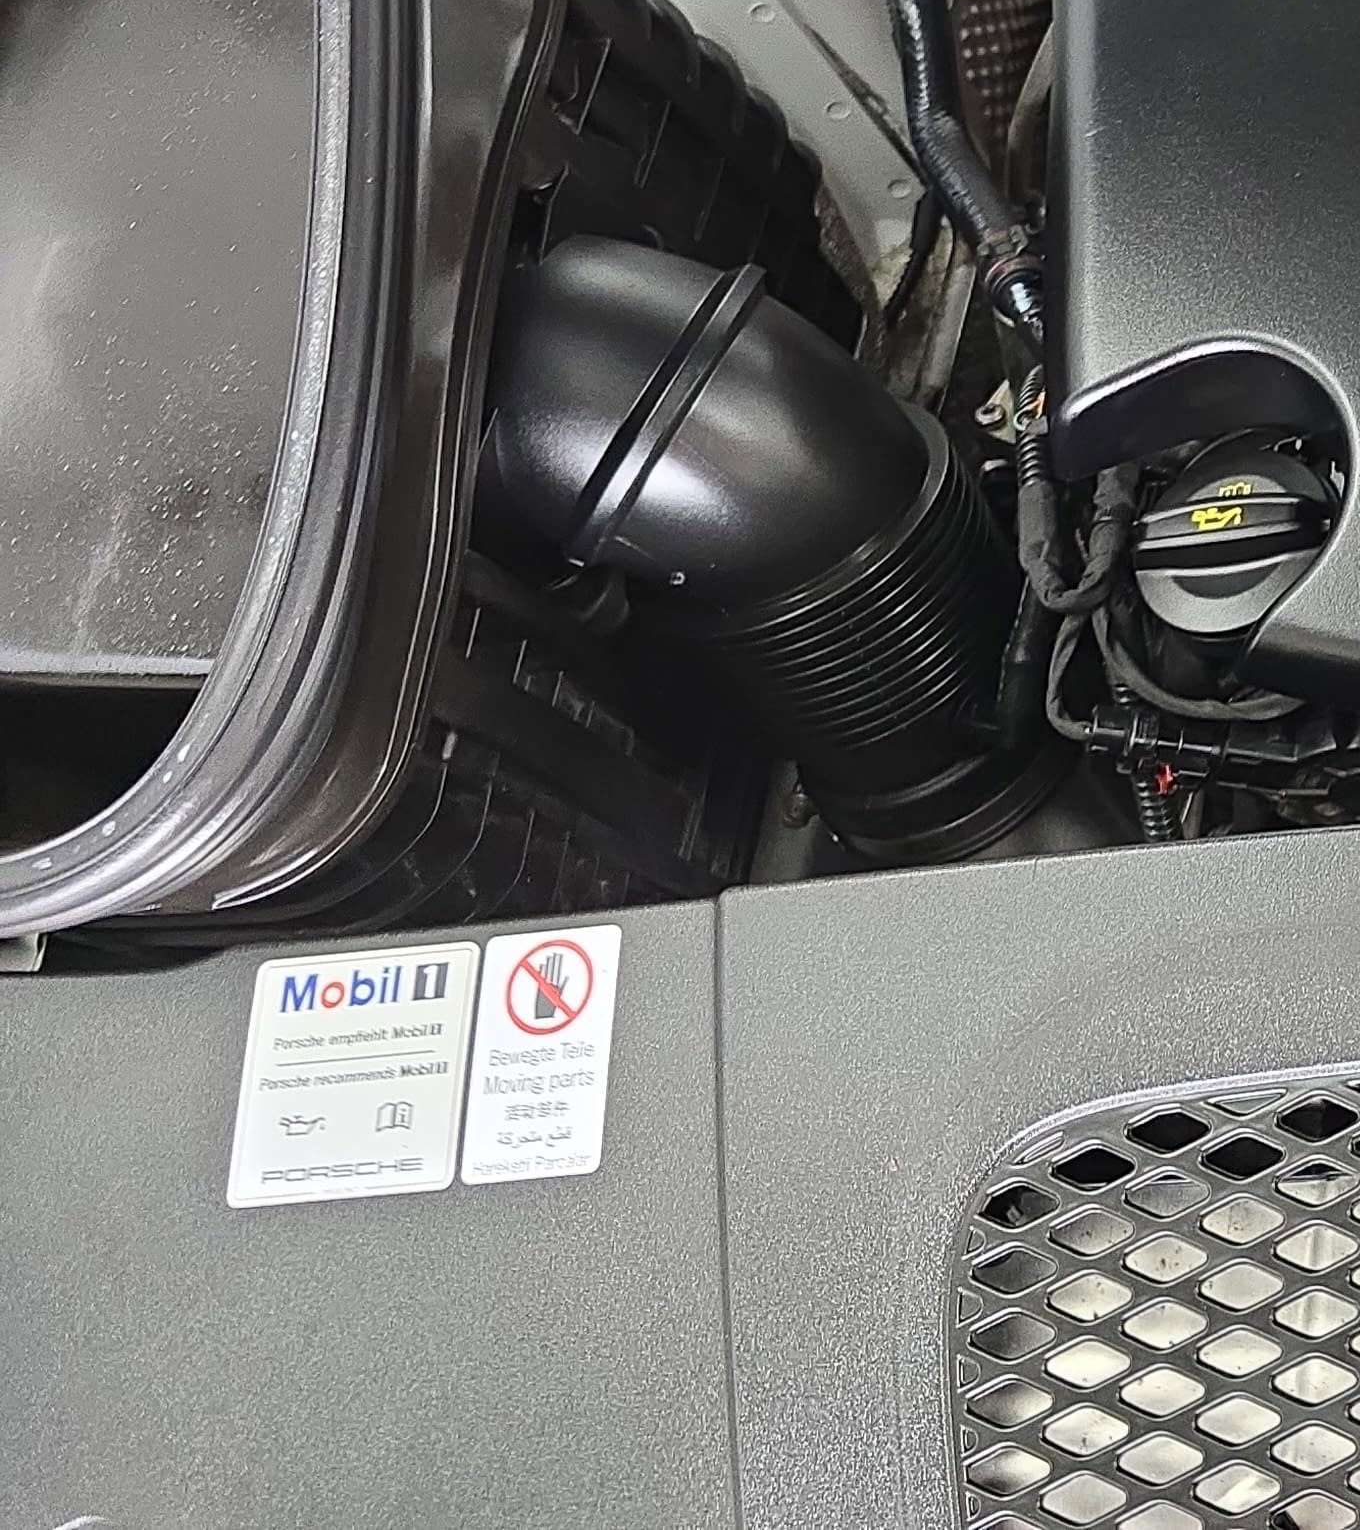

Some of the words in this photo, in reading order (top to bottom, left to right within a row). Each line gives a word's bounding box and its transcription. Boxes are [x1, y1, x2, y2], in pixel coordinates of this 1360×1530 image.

[279, 965, 404, 1013] Mobil
[488, 1047, 557, 1068] Bewegte
[559, 1040, 596, 1060] Teile
[483, 1072, 546, 1096] Moving
[548, 1067, 596, 1093] parts
[260, 1157, 425, 1185] PORSCHE
